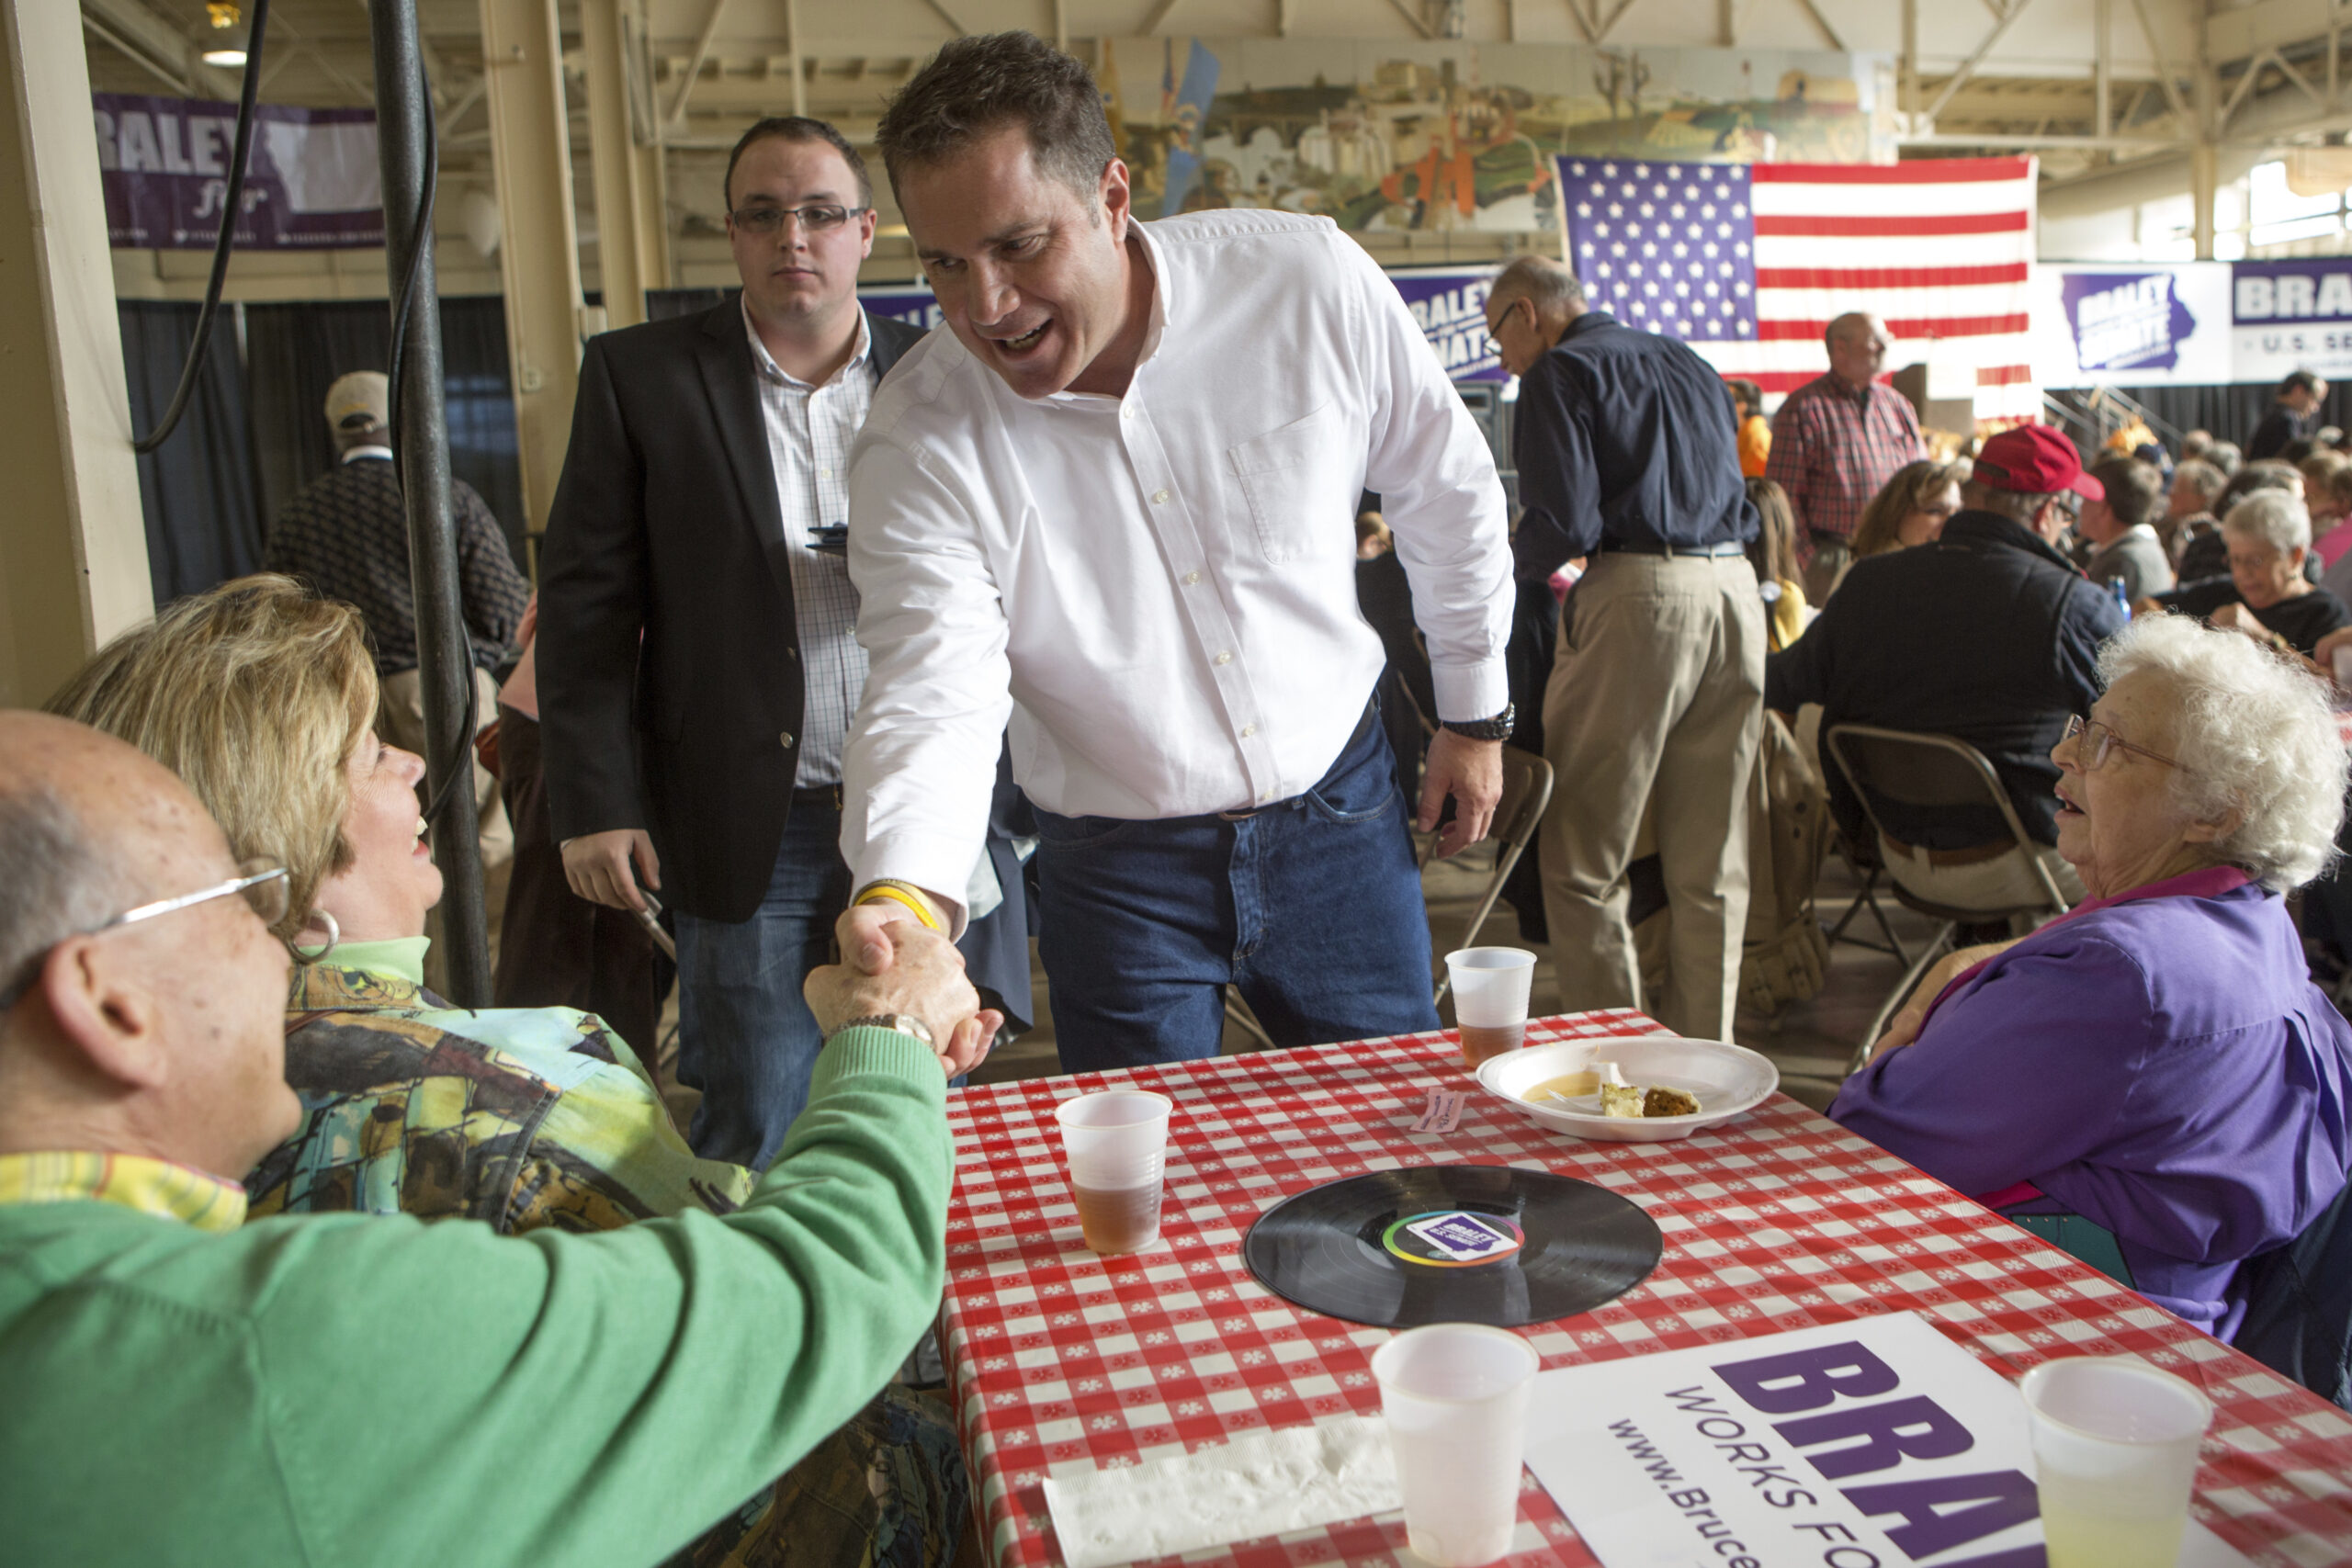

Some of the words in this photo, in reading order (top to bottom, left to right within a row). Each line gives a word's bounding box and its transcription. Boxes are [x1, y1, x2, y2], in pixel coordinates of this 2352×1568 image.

[2235, 272, 2352, 319] BRA
[1664, 1384, 1818, 1508] WORKS
[1791, 1522, 1882, 1568] FO
[1710, 1340, 2051, 1568] BRA
